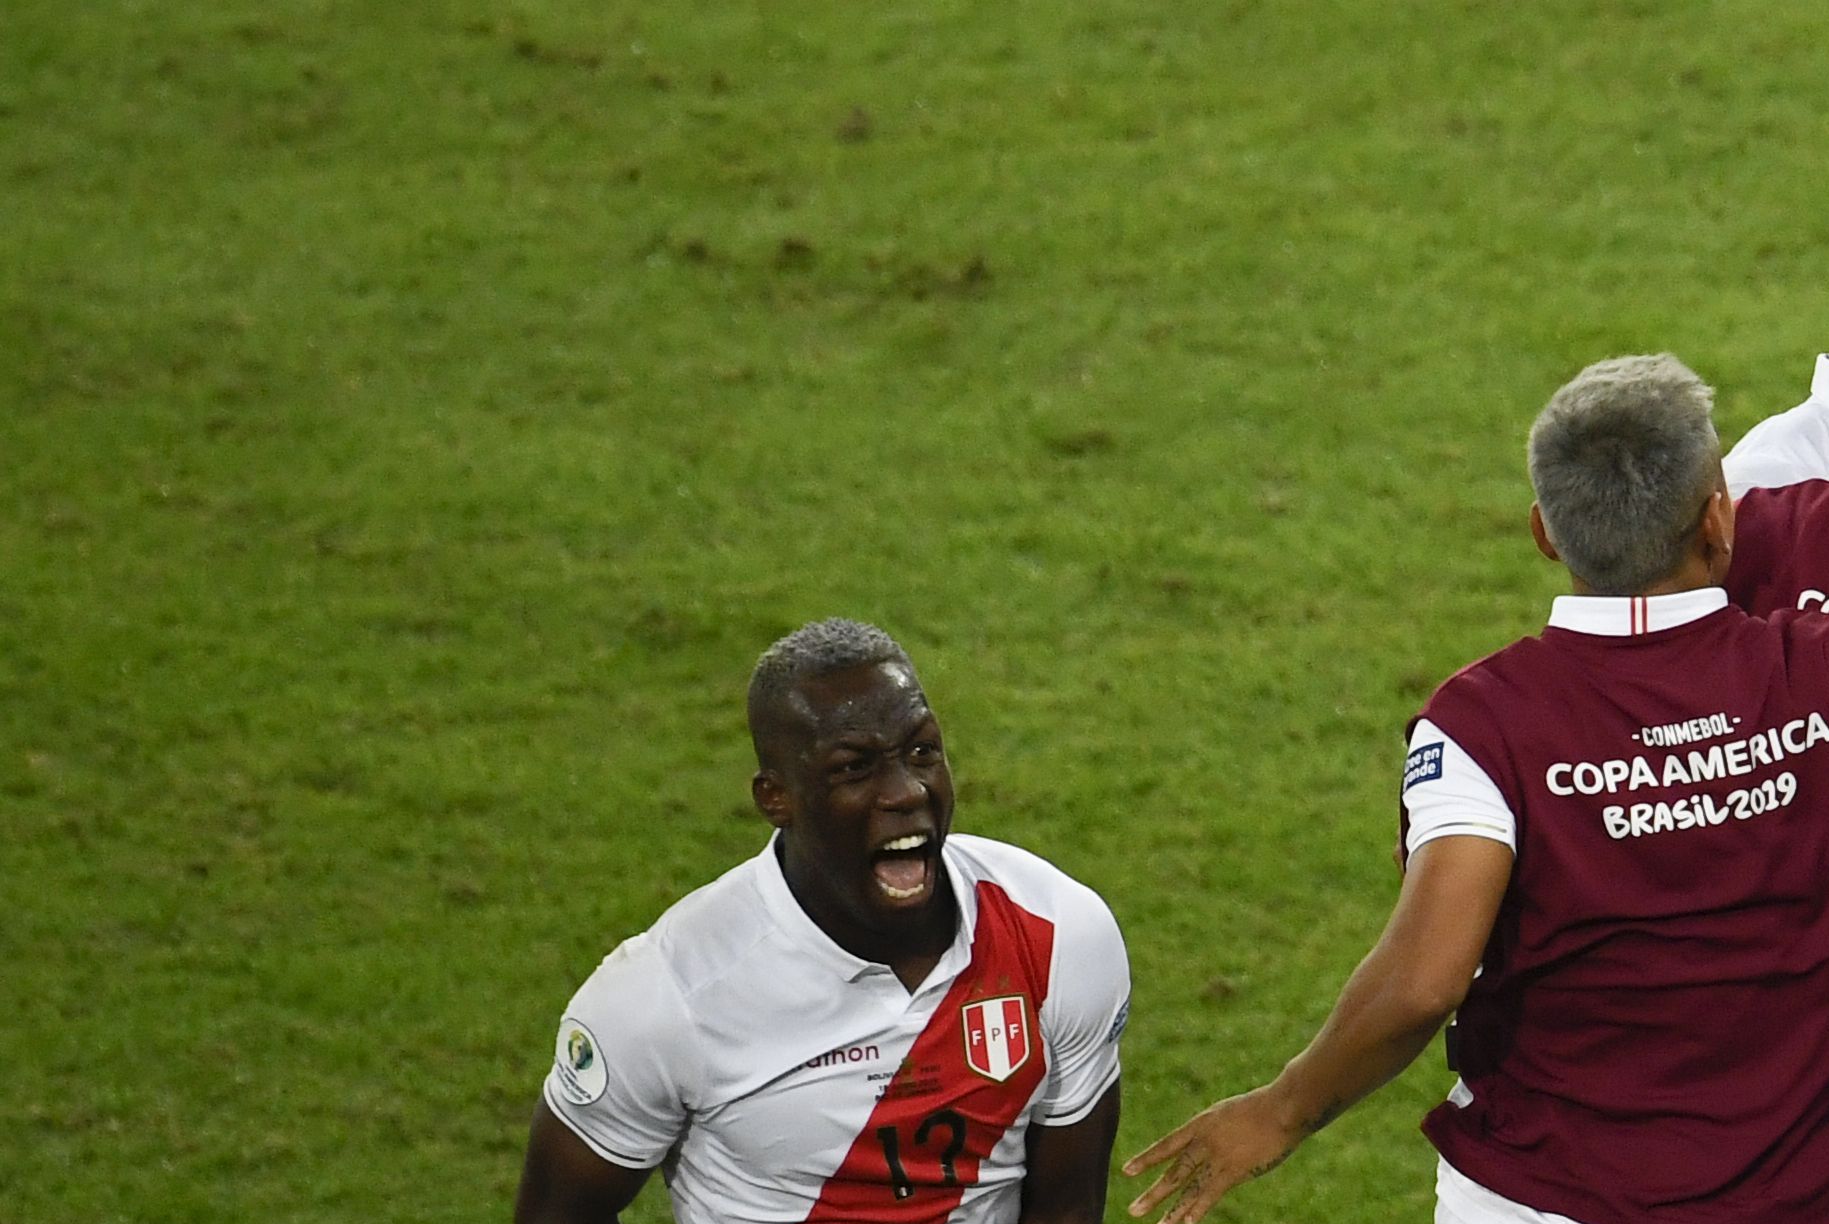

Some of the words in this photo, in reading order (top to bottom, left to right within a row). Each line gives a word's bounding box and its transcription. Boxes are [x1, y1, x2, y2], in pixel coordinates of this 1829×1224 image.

[1423, 747, 1440, 761] en
[1546, 756, 1659, 796] COPA
[1726, 771, 1797, 820] 2019
